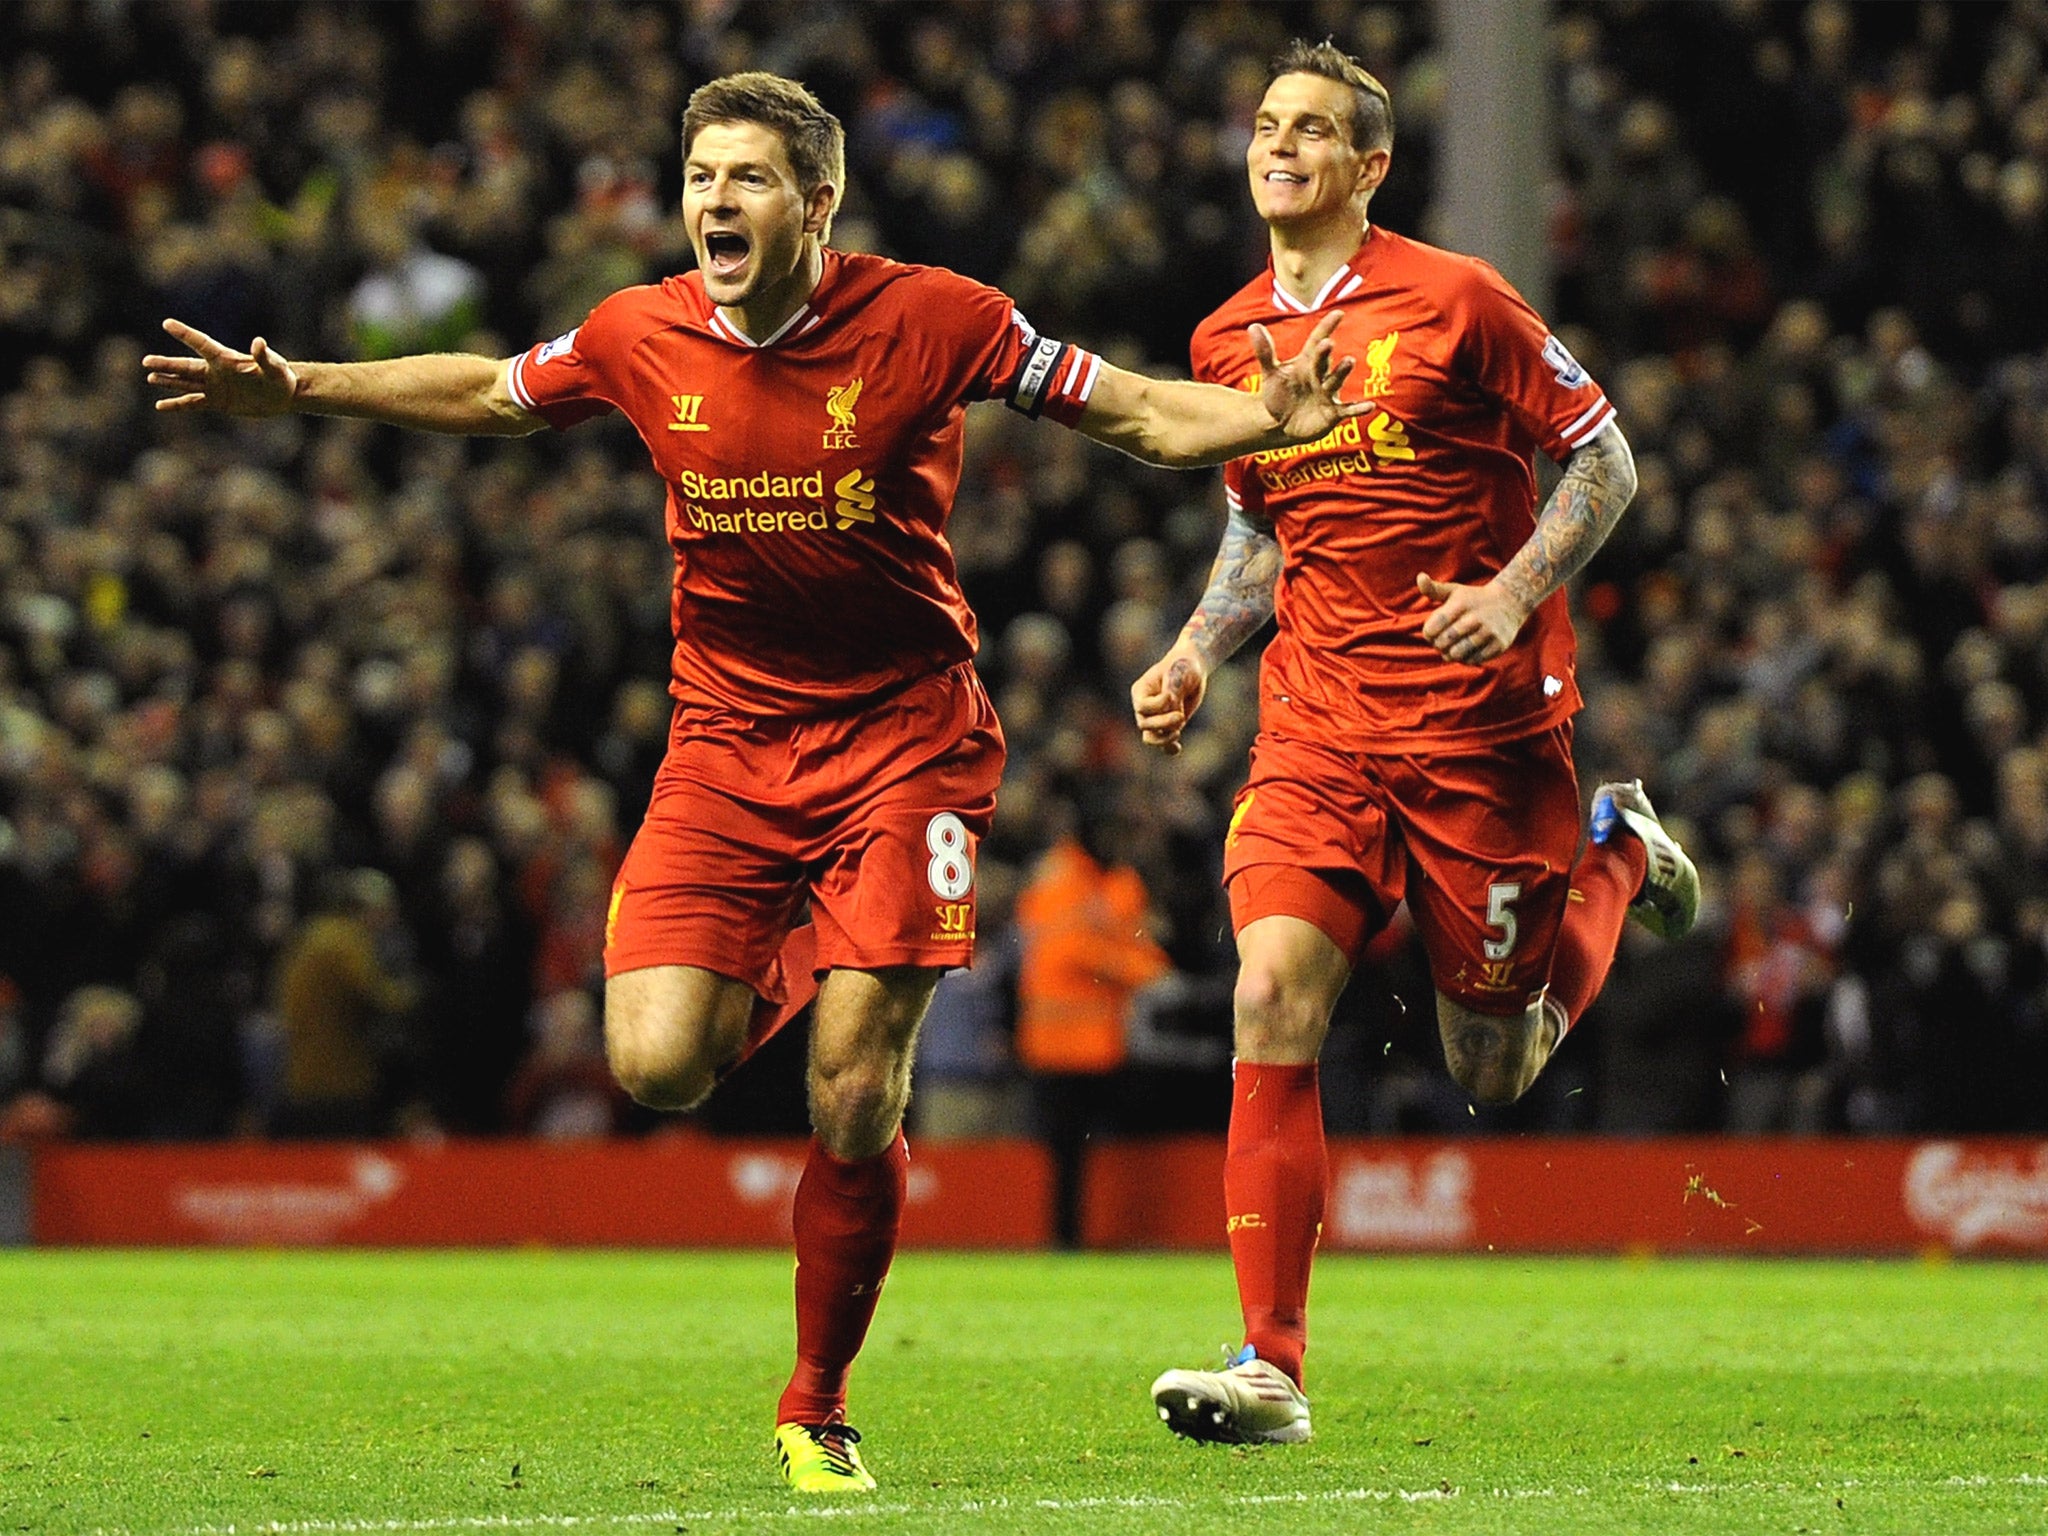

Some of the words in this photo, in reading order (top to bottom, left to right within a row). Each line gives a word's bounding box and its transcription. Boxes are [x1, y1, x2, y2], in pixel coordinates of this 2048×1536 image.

[681, 470, 824, 499] Standard
[1260, 449, 1372, 491] Chartered
[686, 503, 829, 533] Chartered
[926, 811, 973, 901] 8
[1483, 882, 1521, 960] 5
